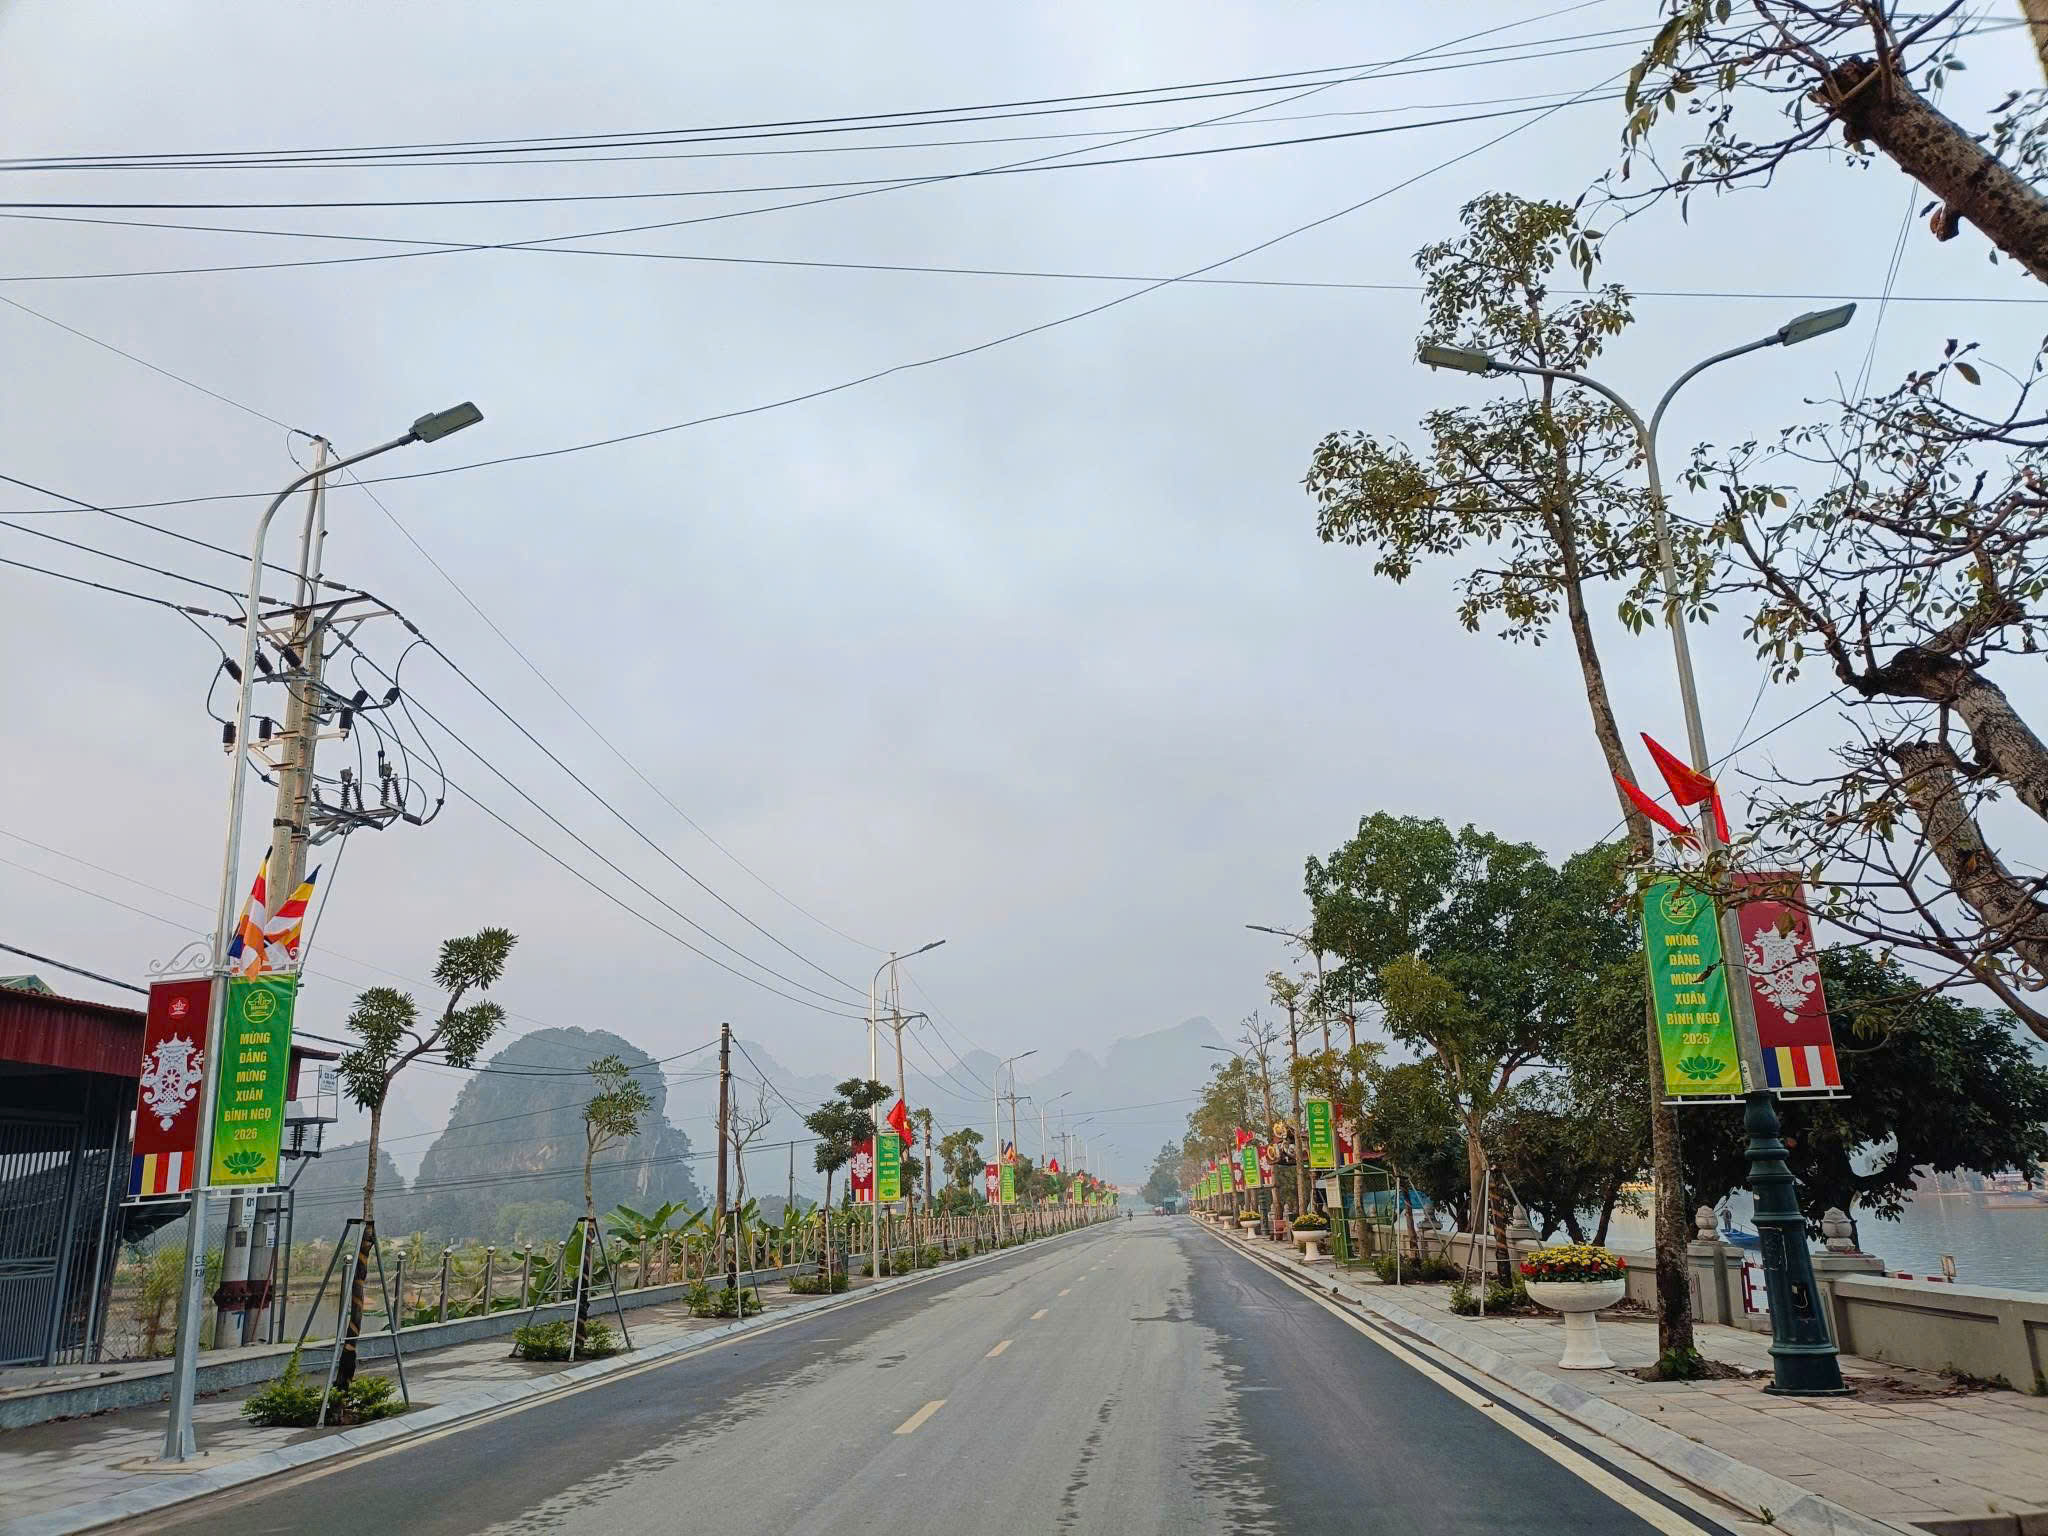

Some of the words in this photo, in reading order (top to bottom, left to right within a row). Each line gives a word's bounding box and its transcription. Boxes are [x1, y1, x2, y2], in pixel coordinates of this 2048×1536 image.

[1665, 932, 1699, 946] MỪNG
[1669, 950, 1700, 966] ĐẢNG
[1675, 990, 1706, 1005] XUÂN
[1696, 1012, 1720, 1026] NGỌ
[240, 1031, 271, 1045] MỪNG
[1682, 1032, 1710, 1045] 2026
[239, 1048, 267, 1063] ĐẢNG
[236, 1069, 267, 1083] MỪNG
[236, 1087, 264, 1102] XUÂN
[224, 1107, 248, 1122] BÍNH
[250, 1107, 272, 1121] NGỌ
[233, 1128, 258, 1141] 2026
